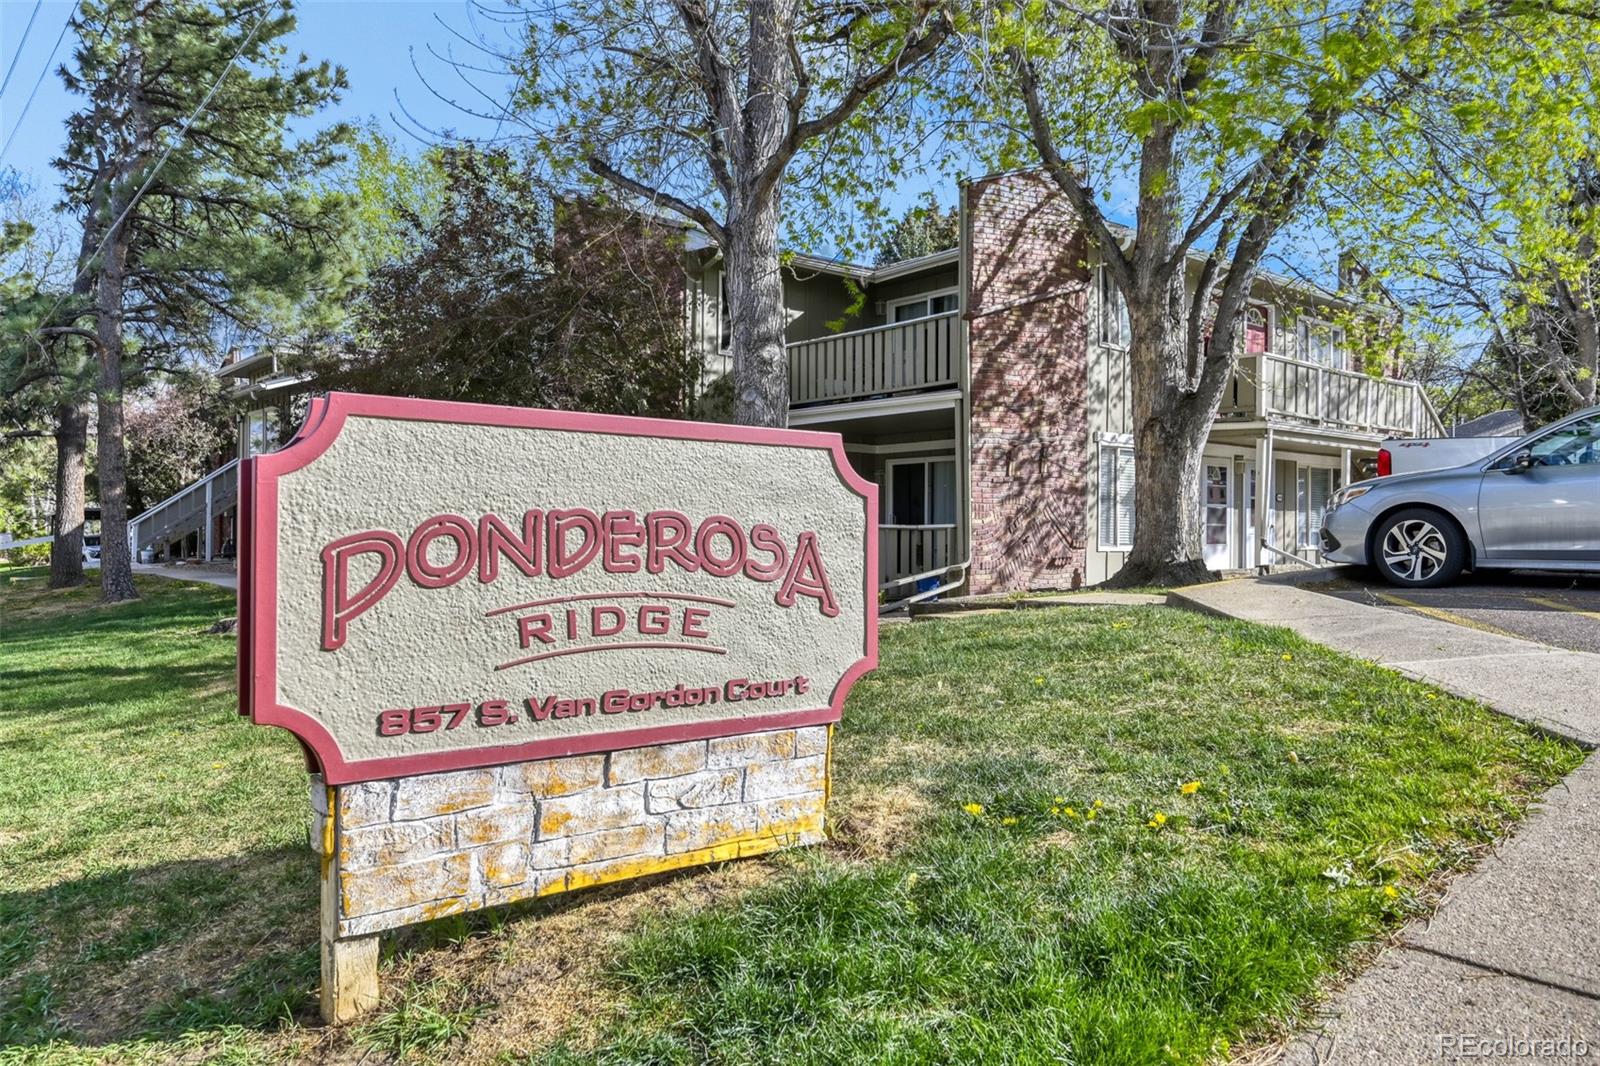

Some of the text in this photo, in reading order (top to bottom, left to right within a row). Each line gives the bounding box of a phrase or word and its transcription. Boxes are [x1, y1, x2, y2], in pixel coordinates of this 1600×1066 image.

[321, 508, 840, 651] PONDEROSA
[517, 604, 712, 648] RIDGE
[377, 675, 810, 737] 857 S. Van Gordon Court
